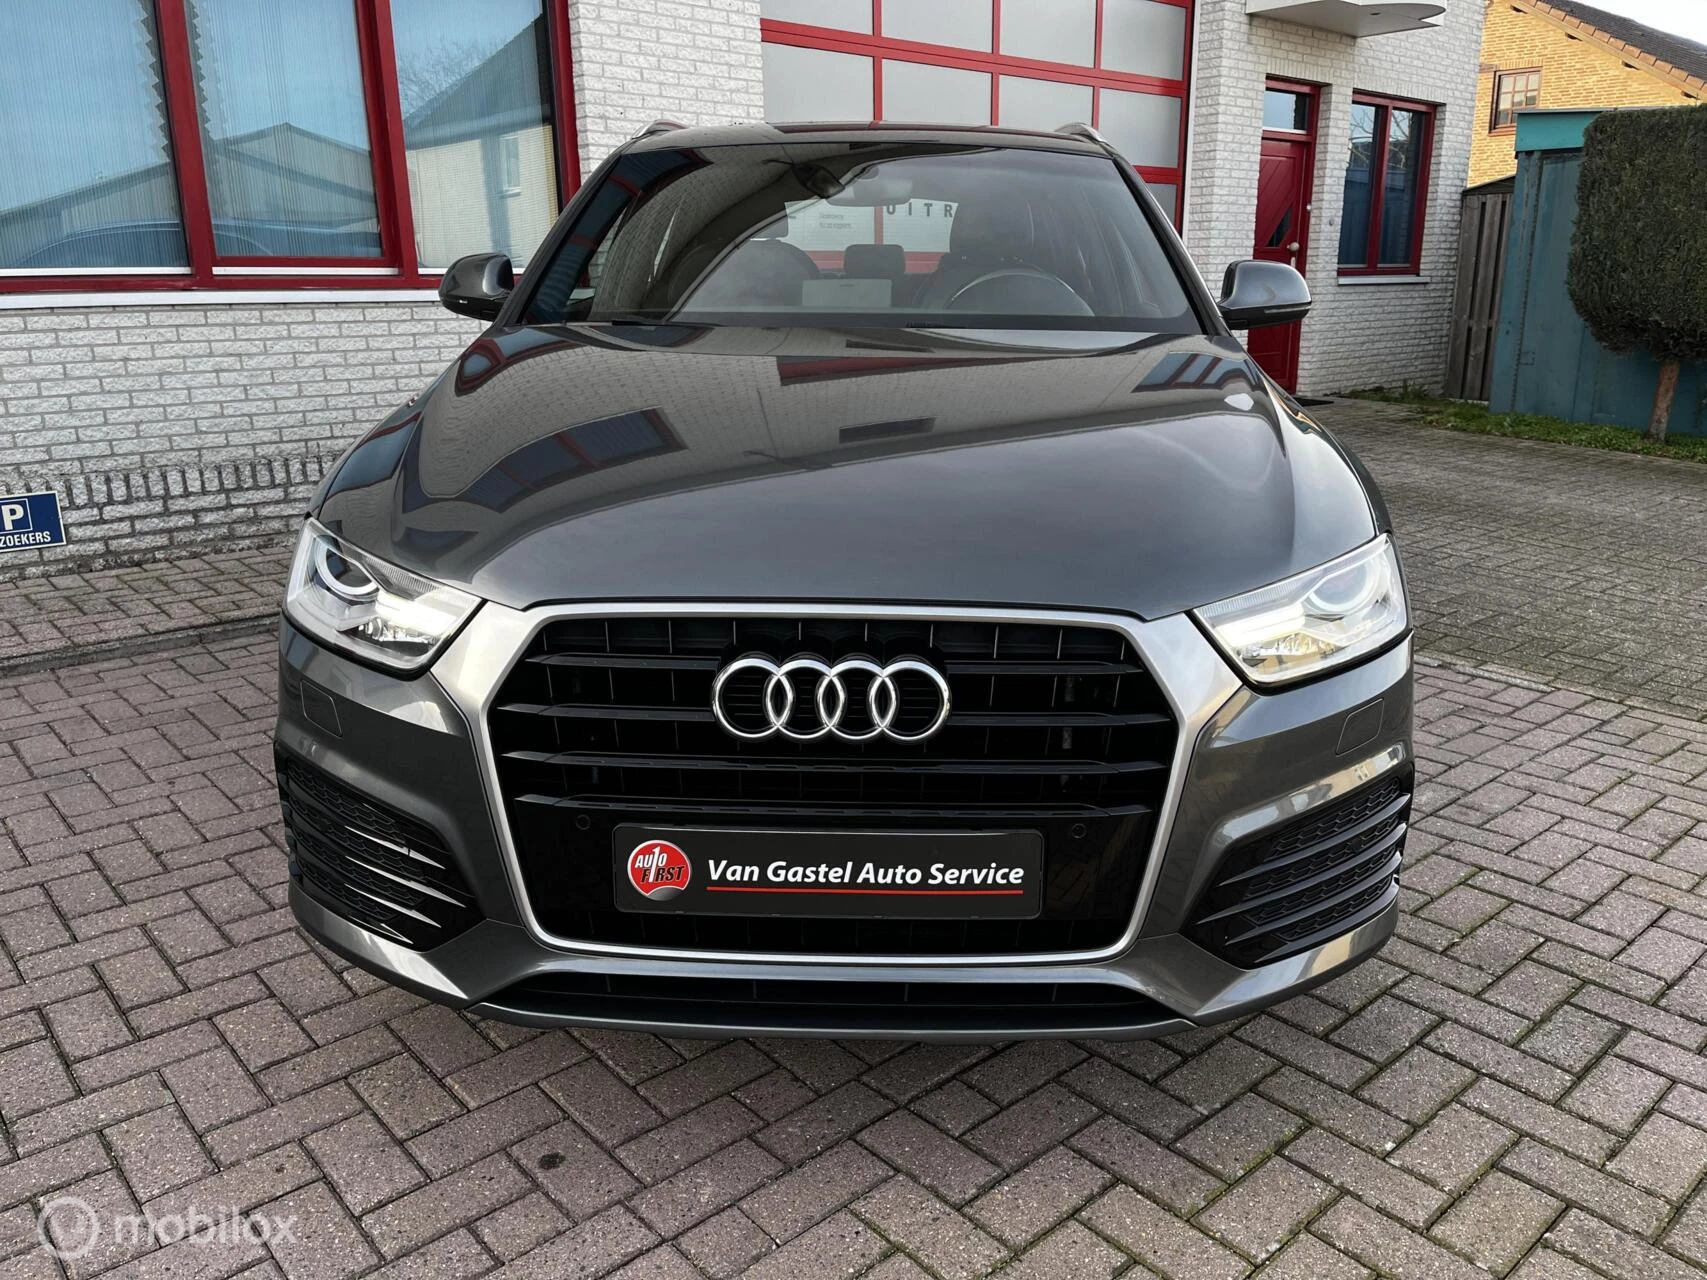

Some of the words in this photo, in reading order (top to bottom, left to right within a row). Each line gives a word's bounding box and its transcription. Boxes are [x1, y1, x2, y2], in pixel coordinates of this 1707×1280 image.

[1, 504, 24, 530] P
[0, 531, 51, 547] ZOEKERS
[708, 859, 760, 882] Van
[766, 861, 853, 883] Gastel
[856, 862, 922, 885] Auto
[927, 862, 1025, 885] Service
